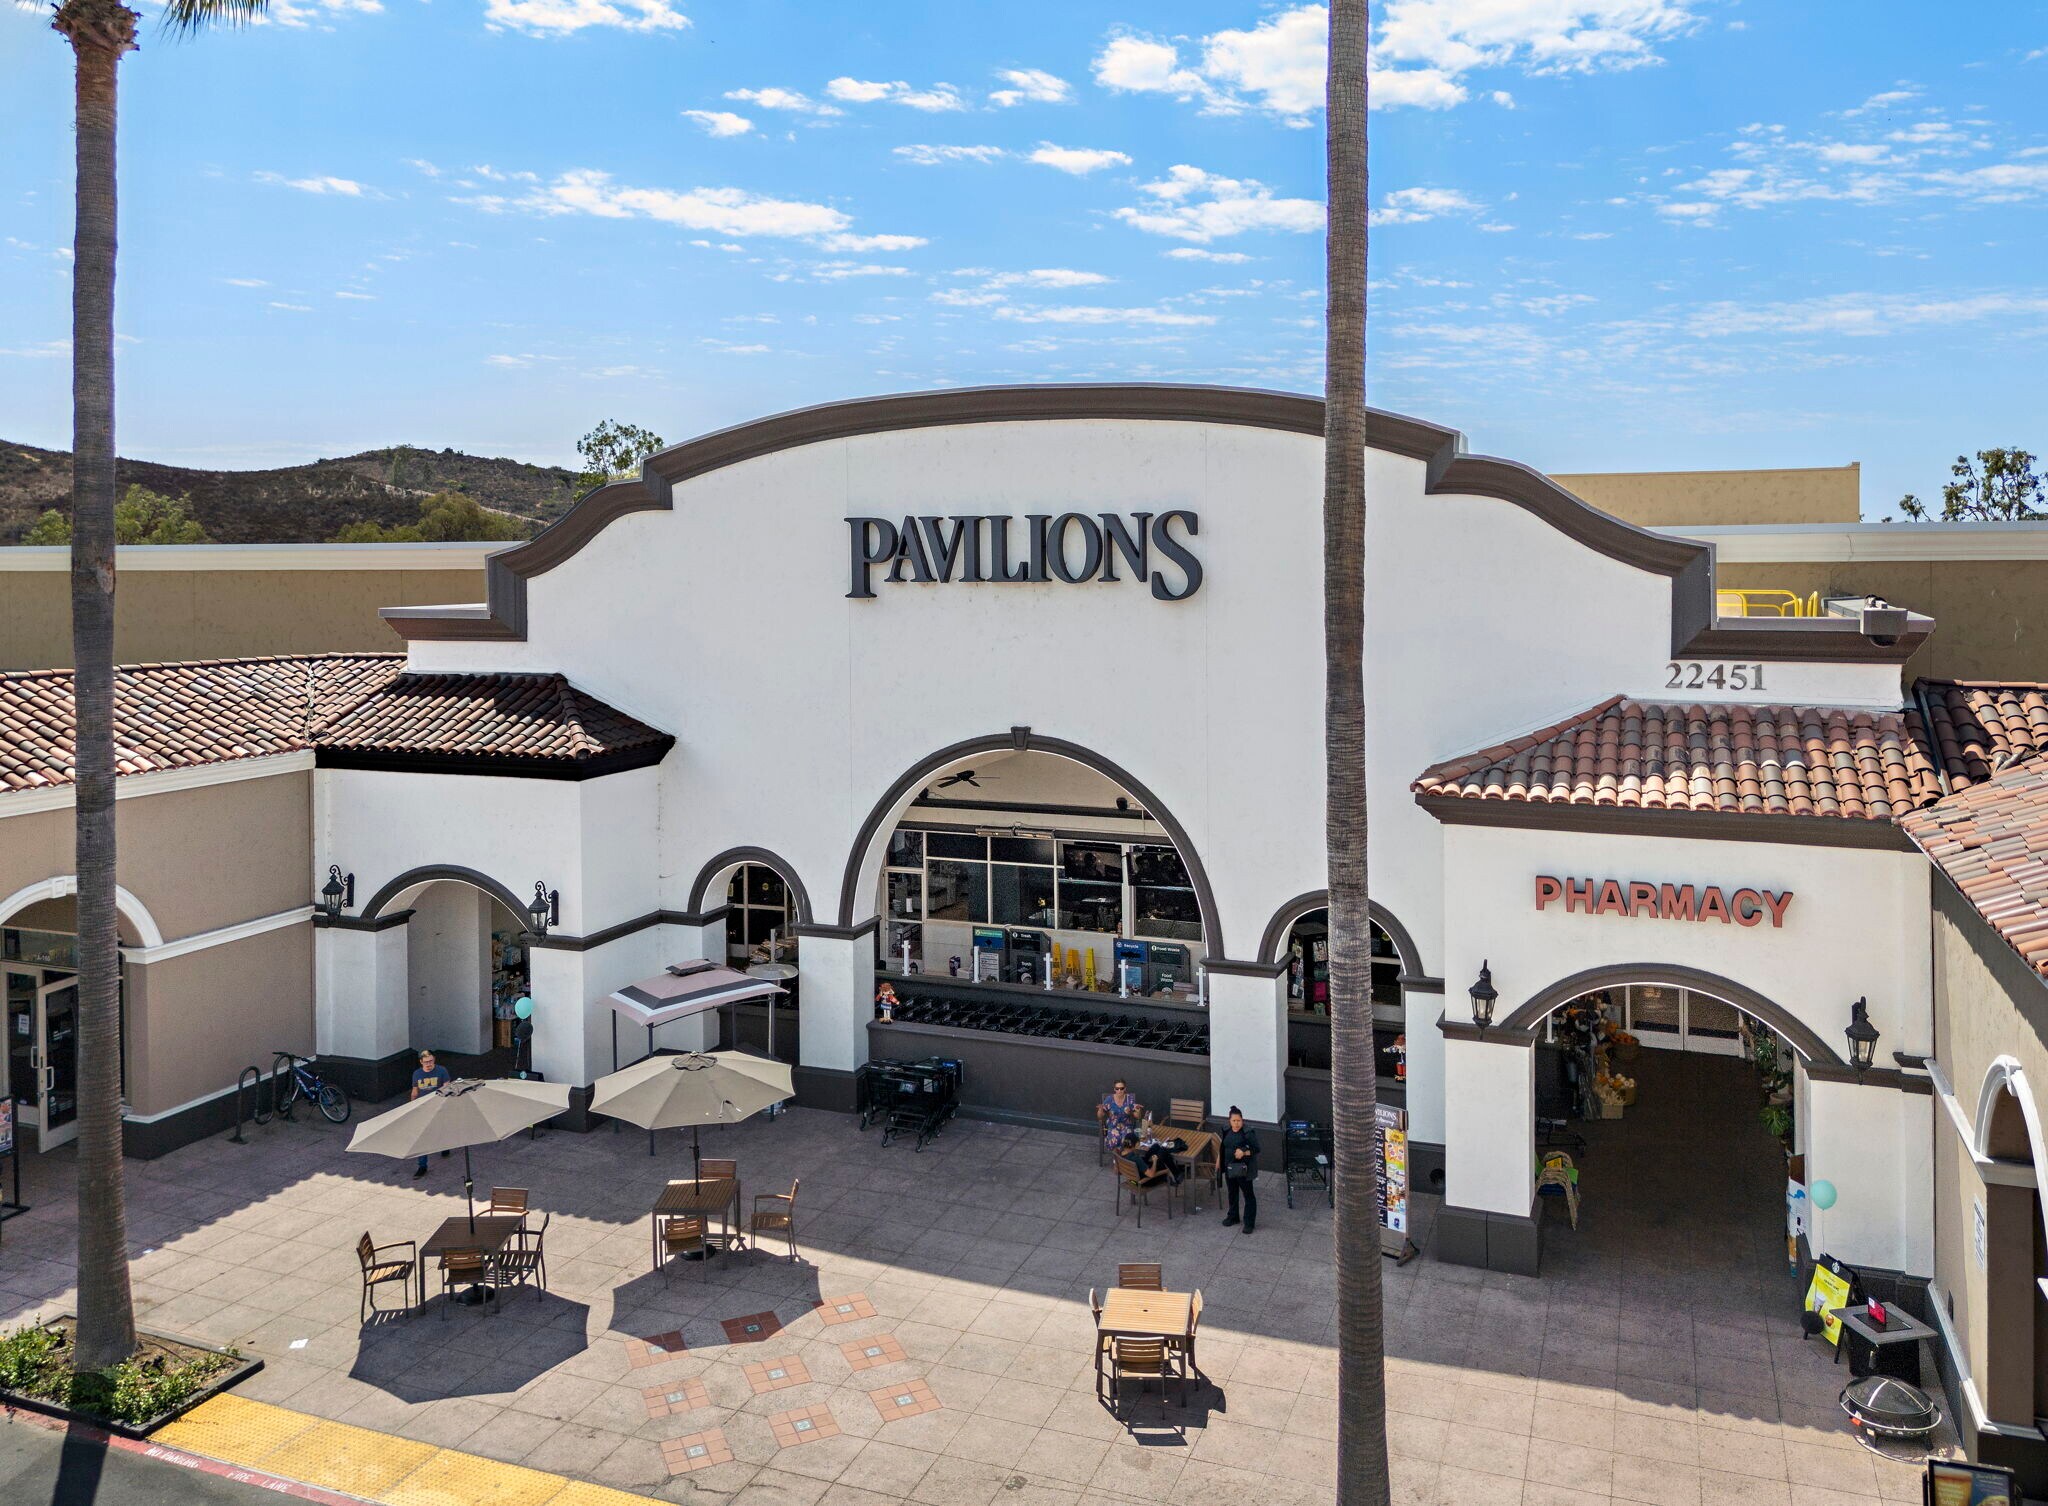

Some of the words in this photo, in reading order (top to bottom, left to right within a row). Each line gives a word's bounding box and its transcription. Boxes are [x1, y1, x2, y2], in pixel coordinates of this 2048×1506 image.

[844, 510, 1203, 601] PAVILIONS
[1665, 663, 1767, 690] 22451
[1535, 875, 1794, 928] PHARMACY
[145, 1447, 163, 1457] NO
[161, 1452, 199, 1468] PARKING
[226, 1470, 255, 1483] FIRE
[260, 1479, 292, 1493] LANE
